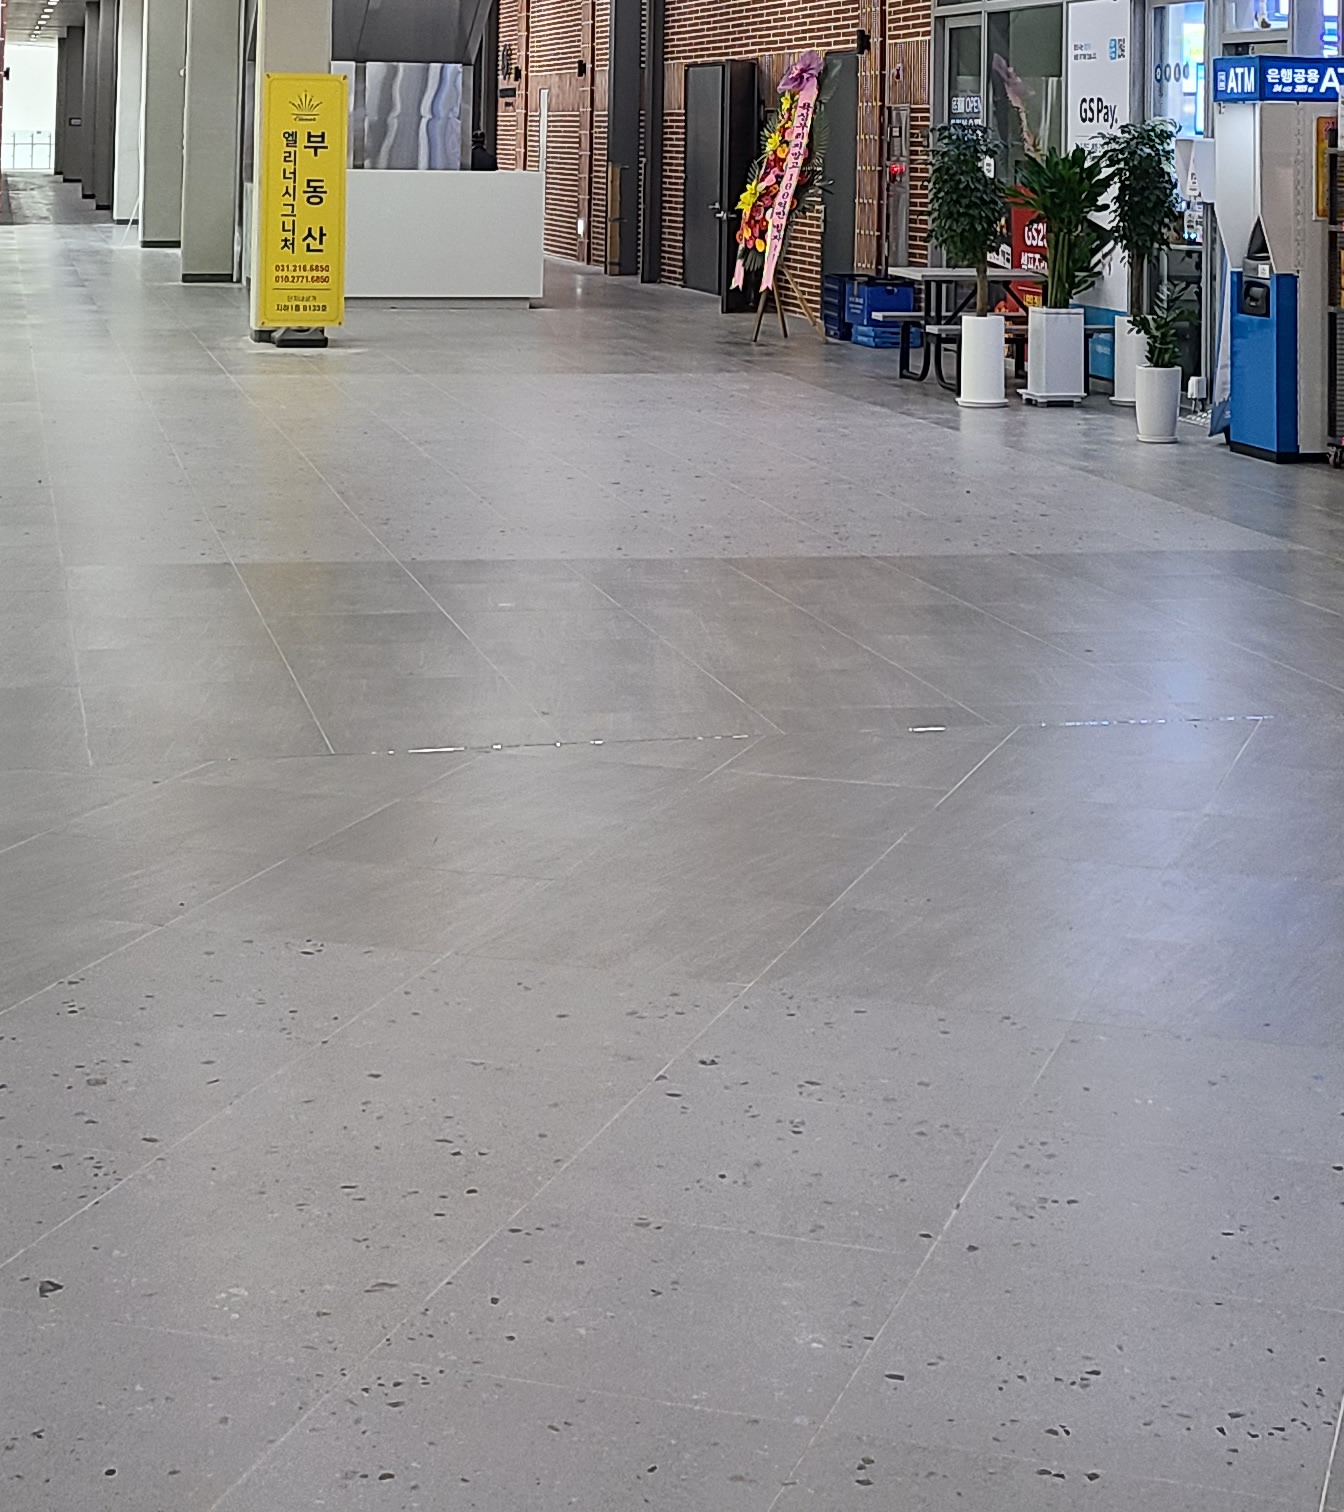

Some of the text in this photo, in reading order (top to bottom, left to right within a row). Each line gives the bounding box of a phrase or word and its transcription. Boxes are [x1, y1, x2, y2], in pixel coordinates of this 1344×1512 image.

[1226, 67, 1255, 94] ATM
[1265, 68, 1320, 84] 은행공용
[279, 130, 298, 255] 엘리너시그니처
[301, 130, 329, 254] 부동산
